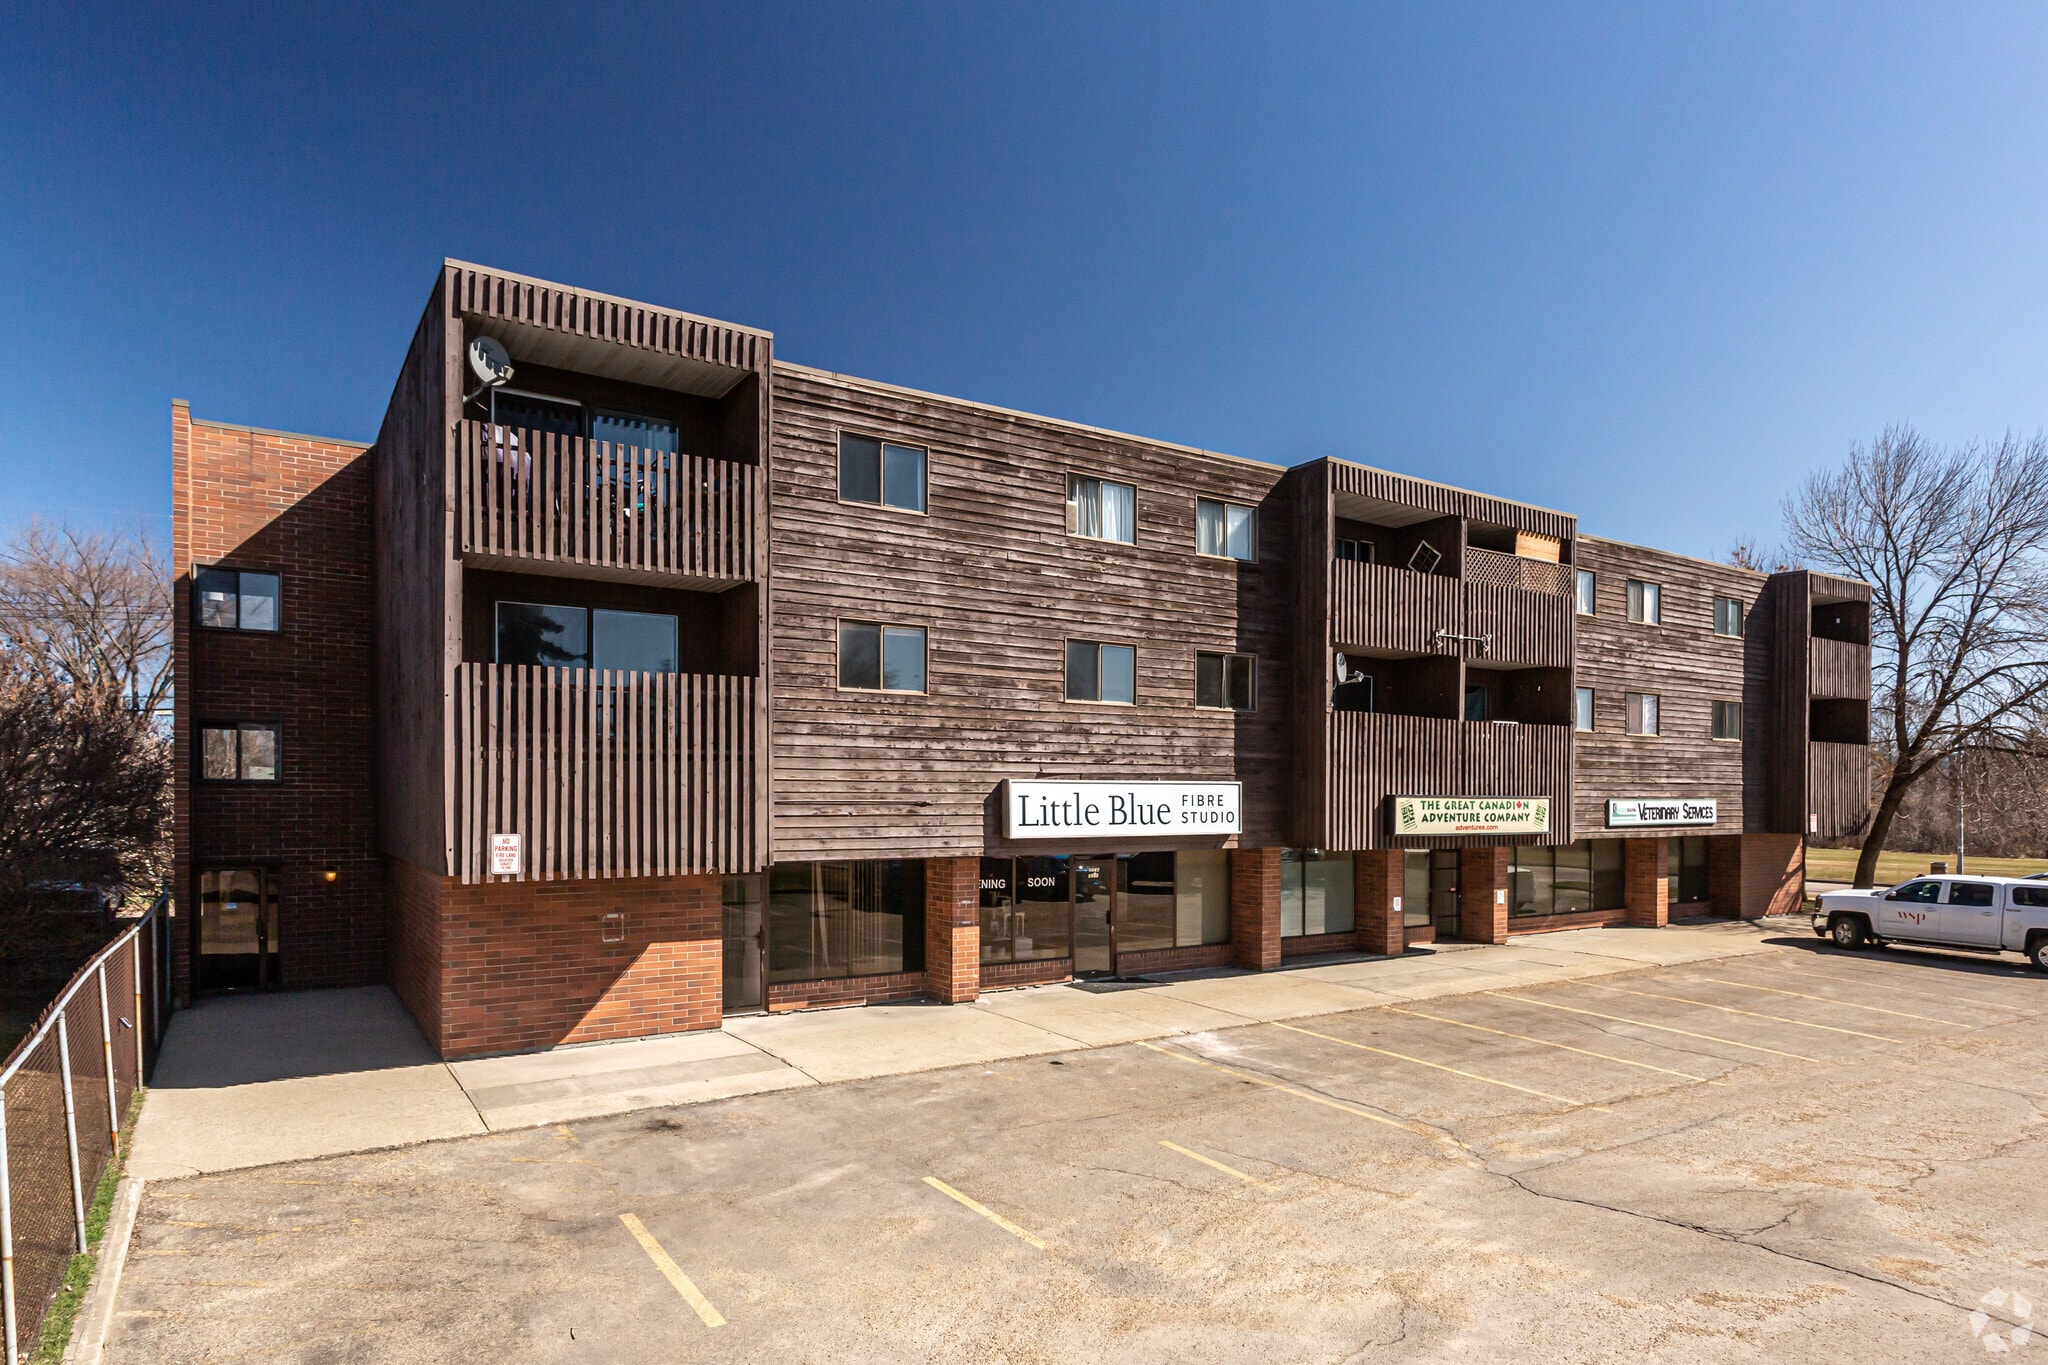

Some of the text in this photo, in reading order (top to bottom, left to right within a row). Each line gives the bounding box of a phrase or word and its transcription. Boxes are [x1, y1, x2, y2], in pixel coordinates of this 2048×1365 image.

[1181, 794, 1224, 807] FIBRE
[1421, 800, 1529, 810] THE GREAT CANADIN
[1018, 792, 1172, 826] Little Blue
[1638, 802, 1680, 821] VETERINARY
[1682, 802, 1713, 820] SERVICES
[1181, 811, 1235, 824] STUDIO
[1421, 812, 1530, 822] ADVENTURE COMPANY
[1027, 877, 1055, 887] SOON
